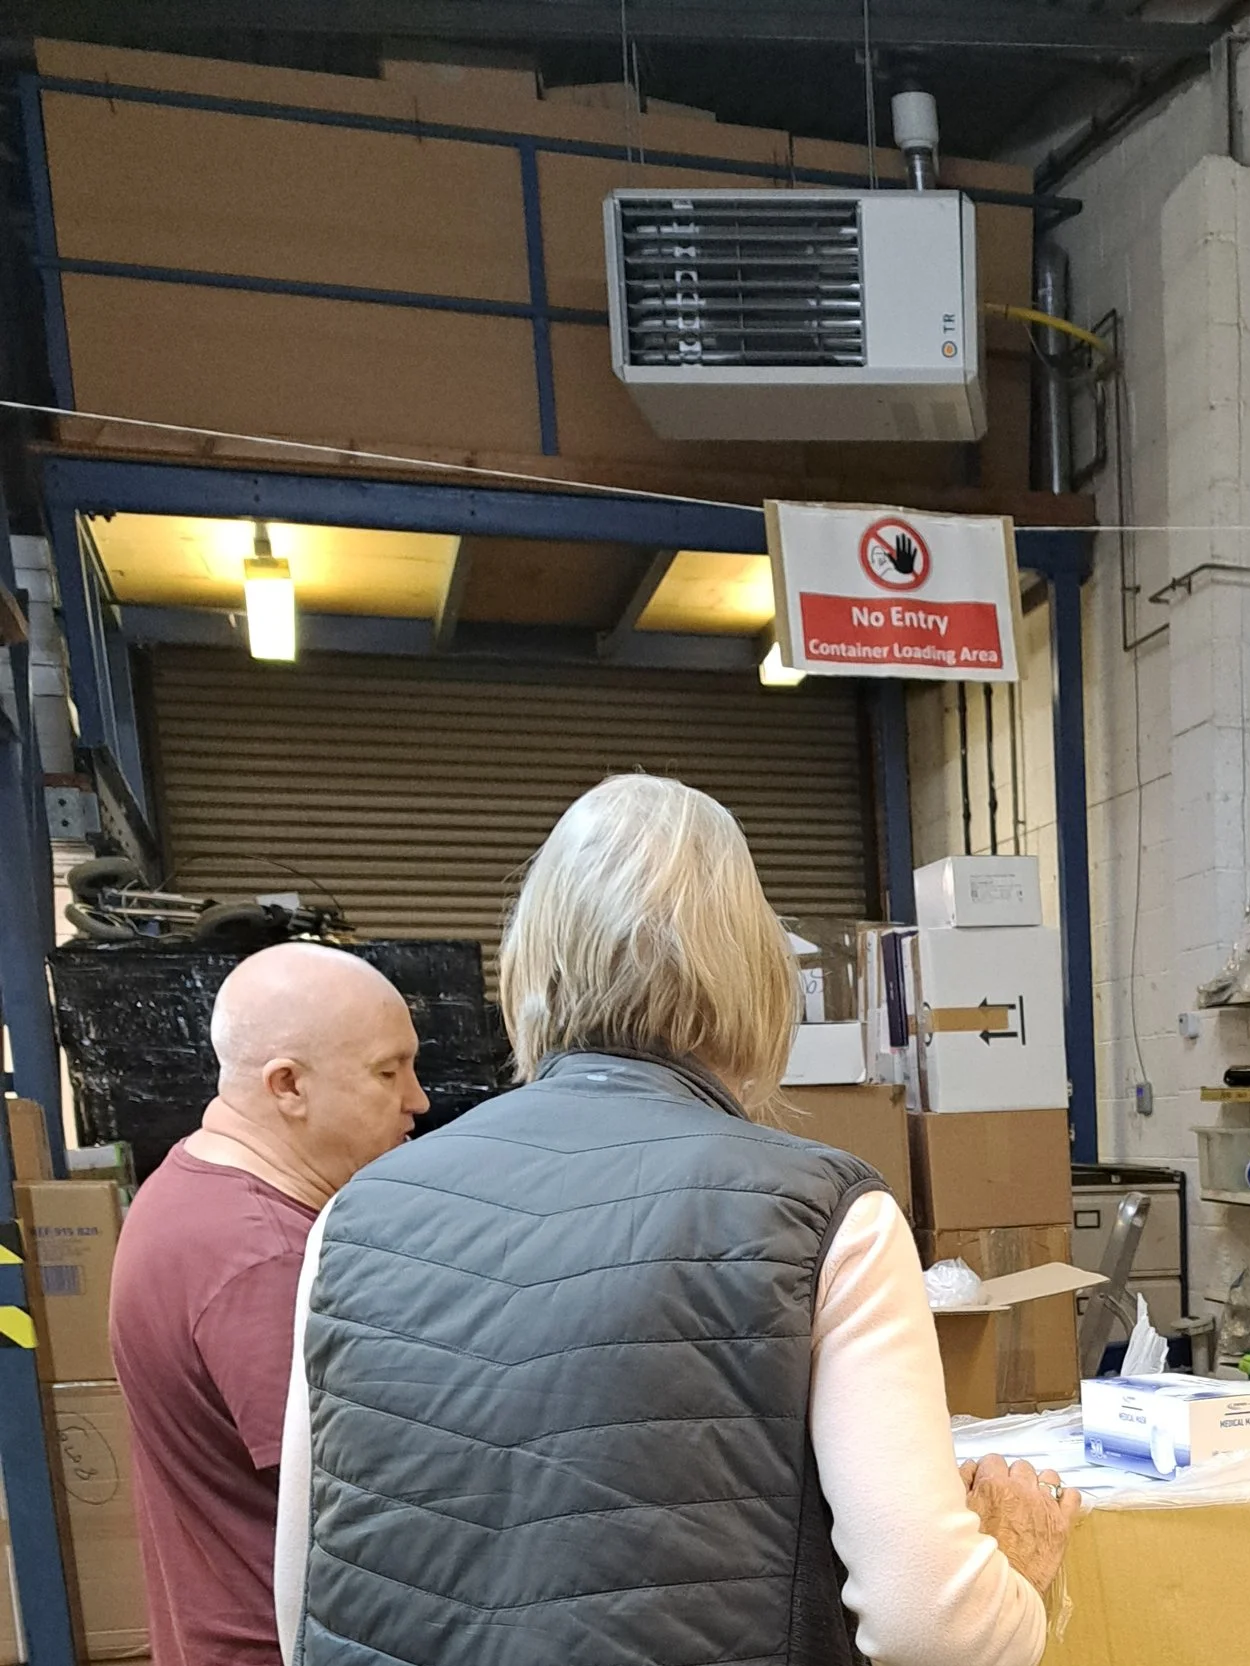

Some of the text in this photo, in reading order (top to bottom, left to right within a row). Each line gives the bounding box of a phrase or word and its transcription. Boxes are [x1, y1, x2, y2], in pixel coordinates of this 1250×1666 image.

[851, 606, 949, 637] No Entry
[808, 638, 998, 666] Container Loading Area
[1219, 1417, 1245, 1428] MEDICAL
